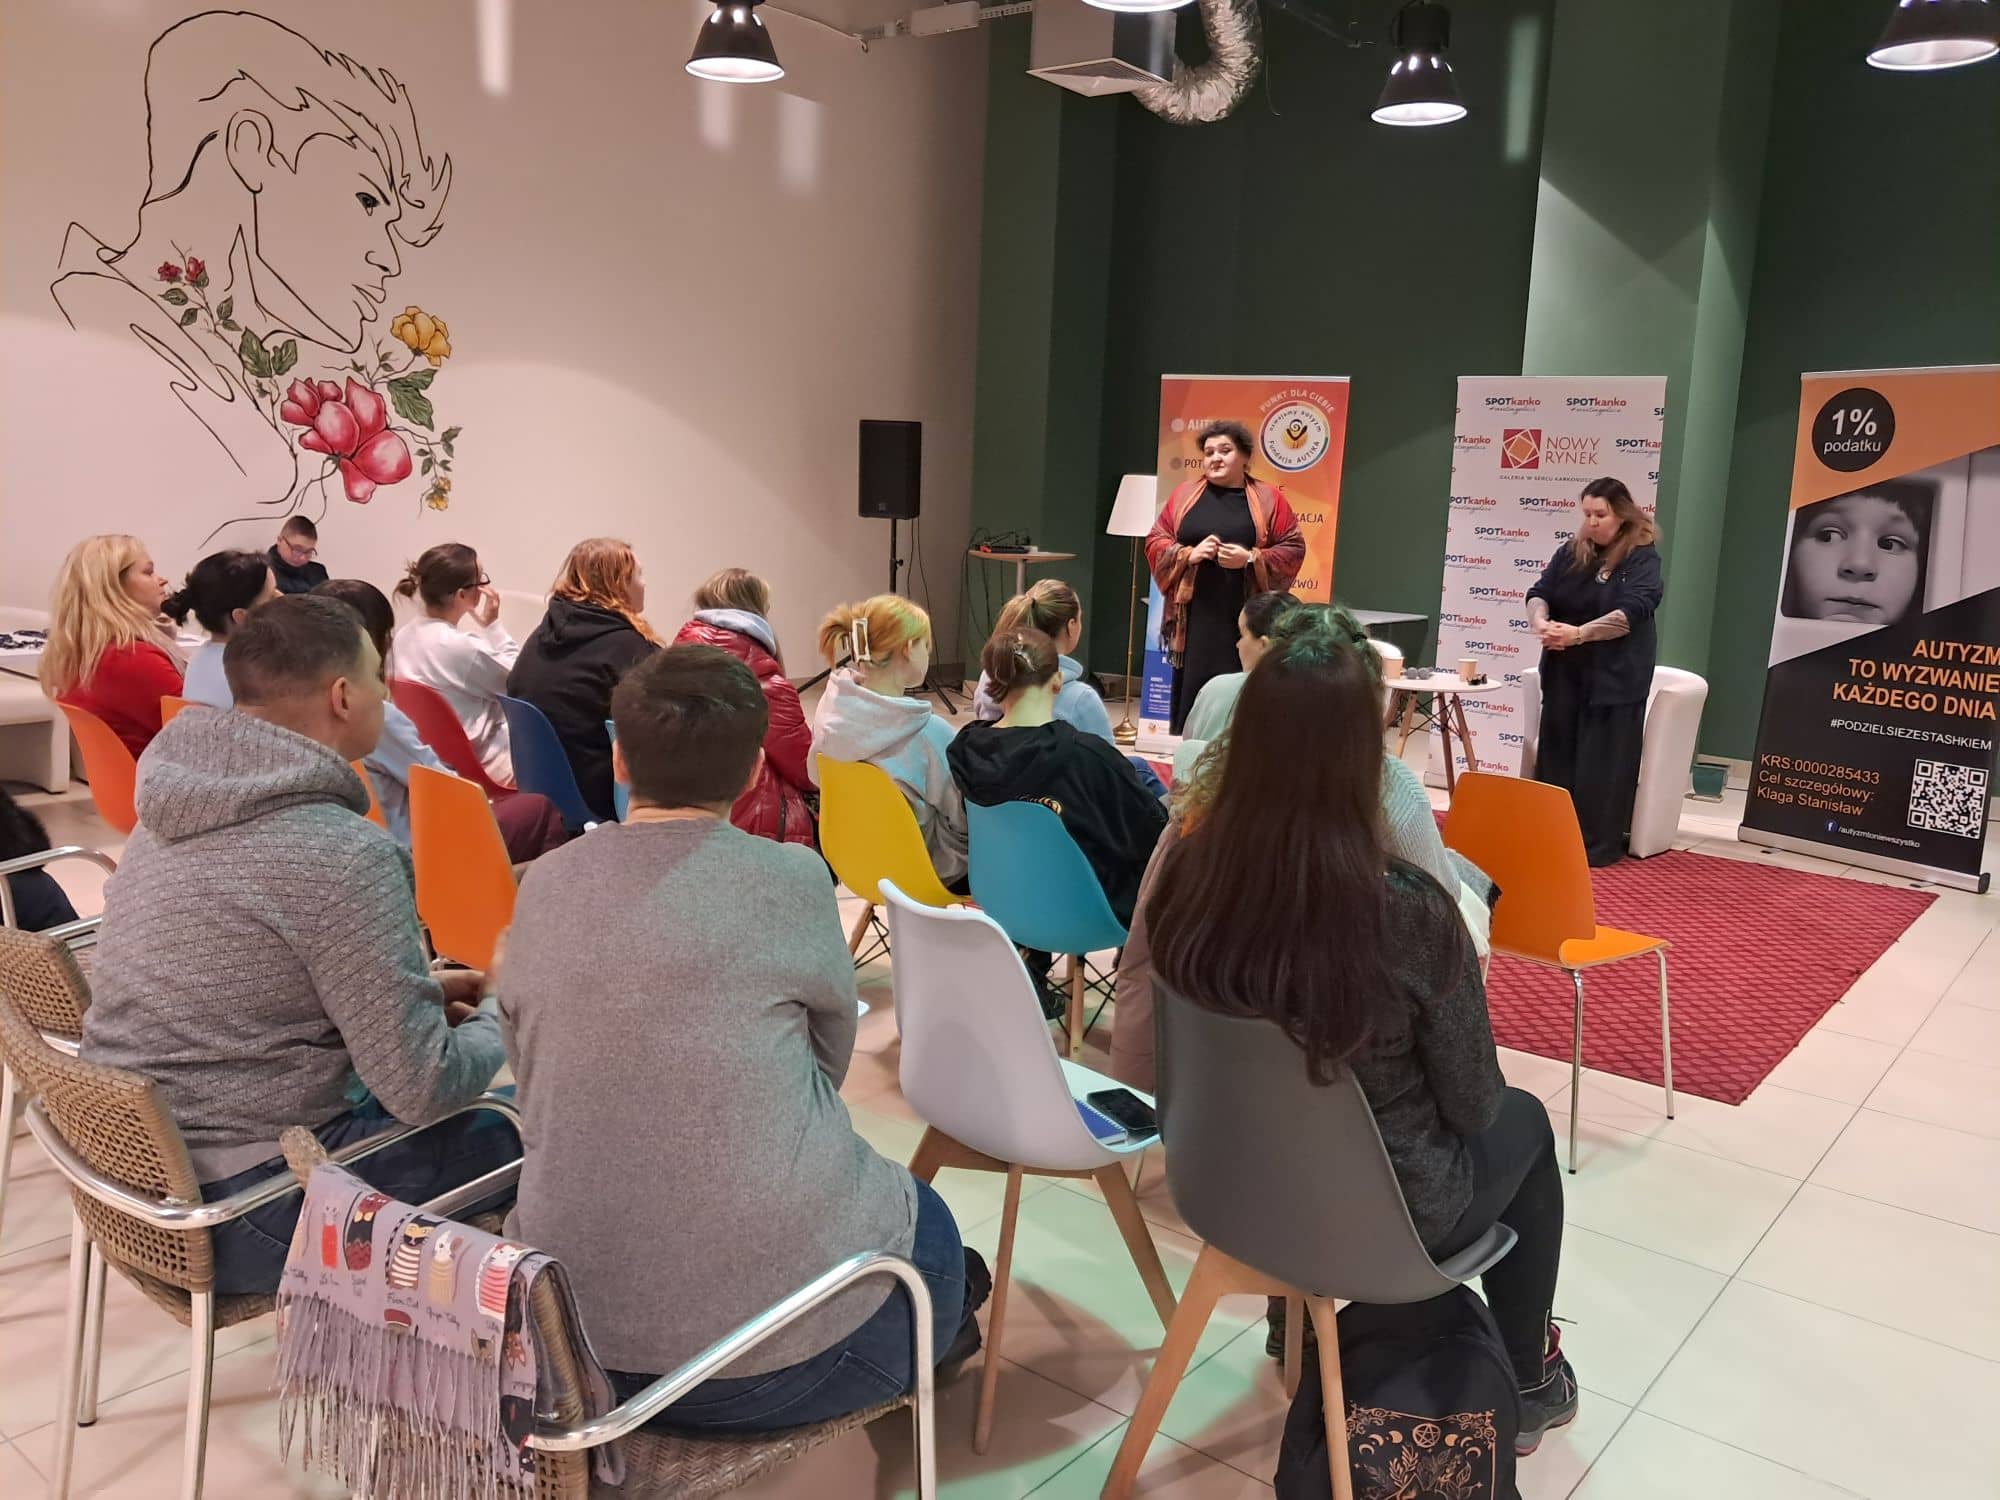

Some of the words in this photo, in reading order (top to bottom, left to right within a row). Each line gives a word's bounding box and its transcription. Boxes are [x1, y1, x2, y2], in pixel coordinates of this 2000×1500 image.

[1290, 389, 1308, 398] DLA
[1309, 392, 1335, 413] CIEBIE
[1485, 396, 1541, 406] SPOTkanko
[1566, 397, 1627, 407] SPOTkanko
[1831, 408, 1878, 436] 1%
[1546, 436, 1600, 450] NOWY
[1824, 439, 1882, 454] podatku
[1296, 441, 1321, 463] AUTIKA
[1545, 451, 1599, 465] RYNEK
[1449, 496, 1497, 506] POTkanko
[1519, 497, 1576, 508] SPOTkanko
[1474, 526, 1530, 538] SPOTkanko
[1445, 554, 1492, 566] POTkanko
[1469, 586, 1525, 599] SPOTkanko
[1440, 613, 1487, 625] POTkanko
[1465, 640, 1520, 654] SPOTkanko
[1912, 639, 2000, 667] AUTYZM
[1849, 658, 1876, 679] TO
[1882, 662, 2000, 694] WYZWANIE
[1460, 699, 1514, 713] SPOTkanko
[1832, 682, 1938, 712] KAŻDEGO
[1943, 695, 1997, 721] DNIA
[1830, 718, 1992, 751] #PODZIELSIEZESTASHKIEM
[1760, 753, 1881, 785] KRS:0000285433
[1758, 769, 1781, 785] Cel
[1784, 777, 1875, 804] szczegółowy:
[1757, 785, 1794, 804] Klaga
[1797, 793, 1865, 816] Stanisław
